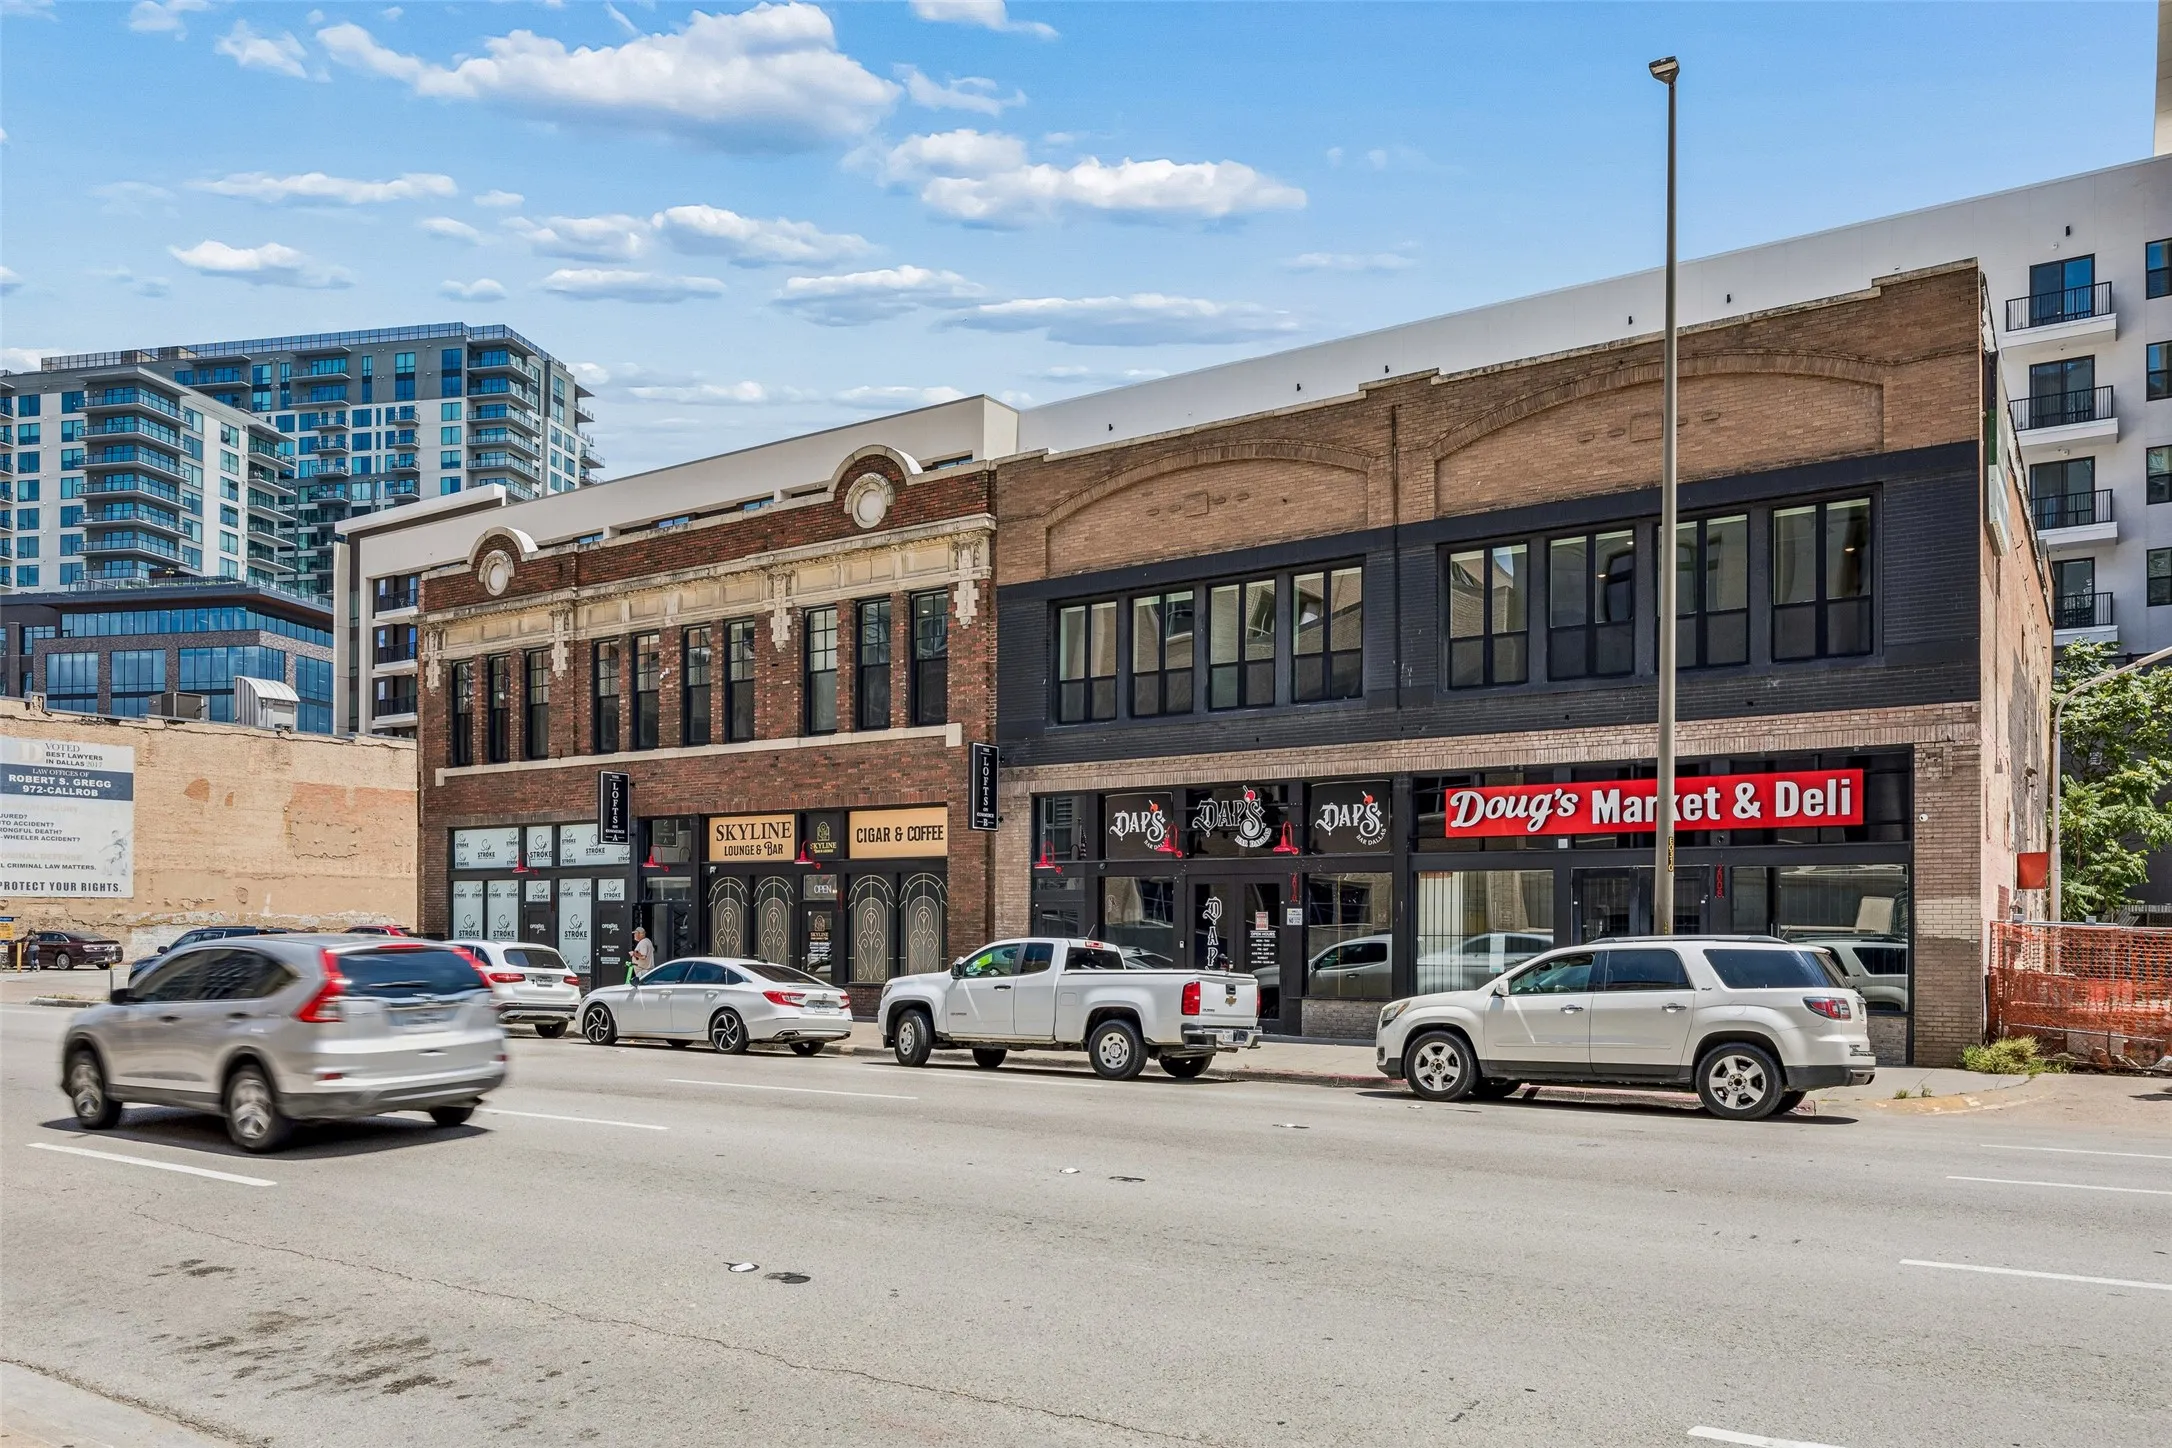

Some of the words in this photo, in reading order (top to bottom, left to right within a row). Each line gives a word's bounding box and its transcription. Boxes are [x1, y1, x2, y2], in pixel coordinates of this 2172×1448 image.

[45, 743, 80, 752] VOTED
[68, 753, 103, 761] LAWYERS
[49, 769, 77, 777] OFFICES
[9, 774, 55, 785] ROBERT
[59, 777, 69, 786] S.
[73, 778, 112, 788] GREGG
[23, 785, 98, 797] 972-CALLROB
[1450, 788, 1579, 832] Doug's
[1732, 782, 1761, 819] &
[1775, 779, 1850, 818] Deli
[983, 818, 988, 827] B
[716, 821, 792, 842] SKYLINE
[856, 827, 890, 843] CIGAR
[895, 826, 903, 842] &
[907, 825, 944, 842] COFFEE
[1356, 834, 1367, 846] BAR
[1367, 828, 1387, 846] DALLAS
[724, 845, 755, 857] LOUNGE
[756, 844, 762, 855] &
[810, 841, 837, 850] SKYLINE
[0, 881, 45, 891] PROTECT
[50, 881, 76, 892] YOUR
[81, 882, 122, 893] RIGHTS.
[813, 885, 832, 894] OPEN
[493, 930, 515, 938] STROKE
[1202, 896, 1223, 971] DAP
